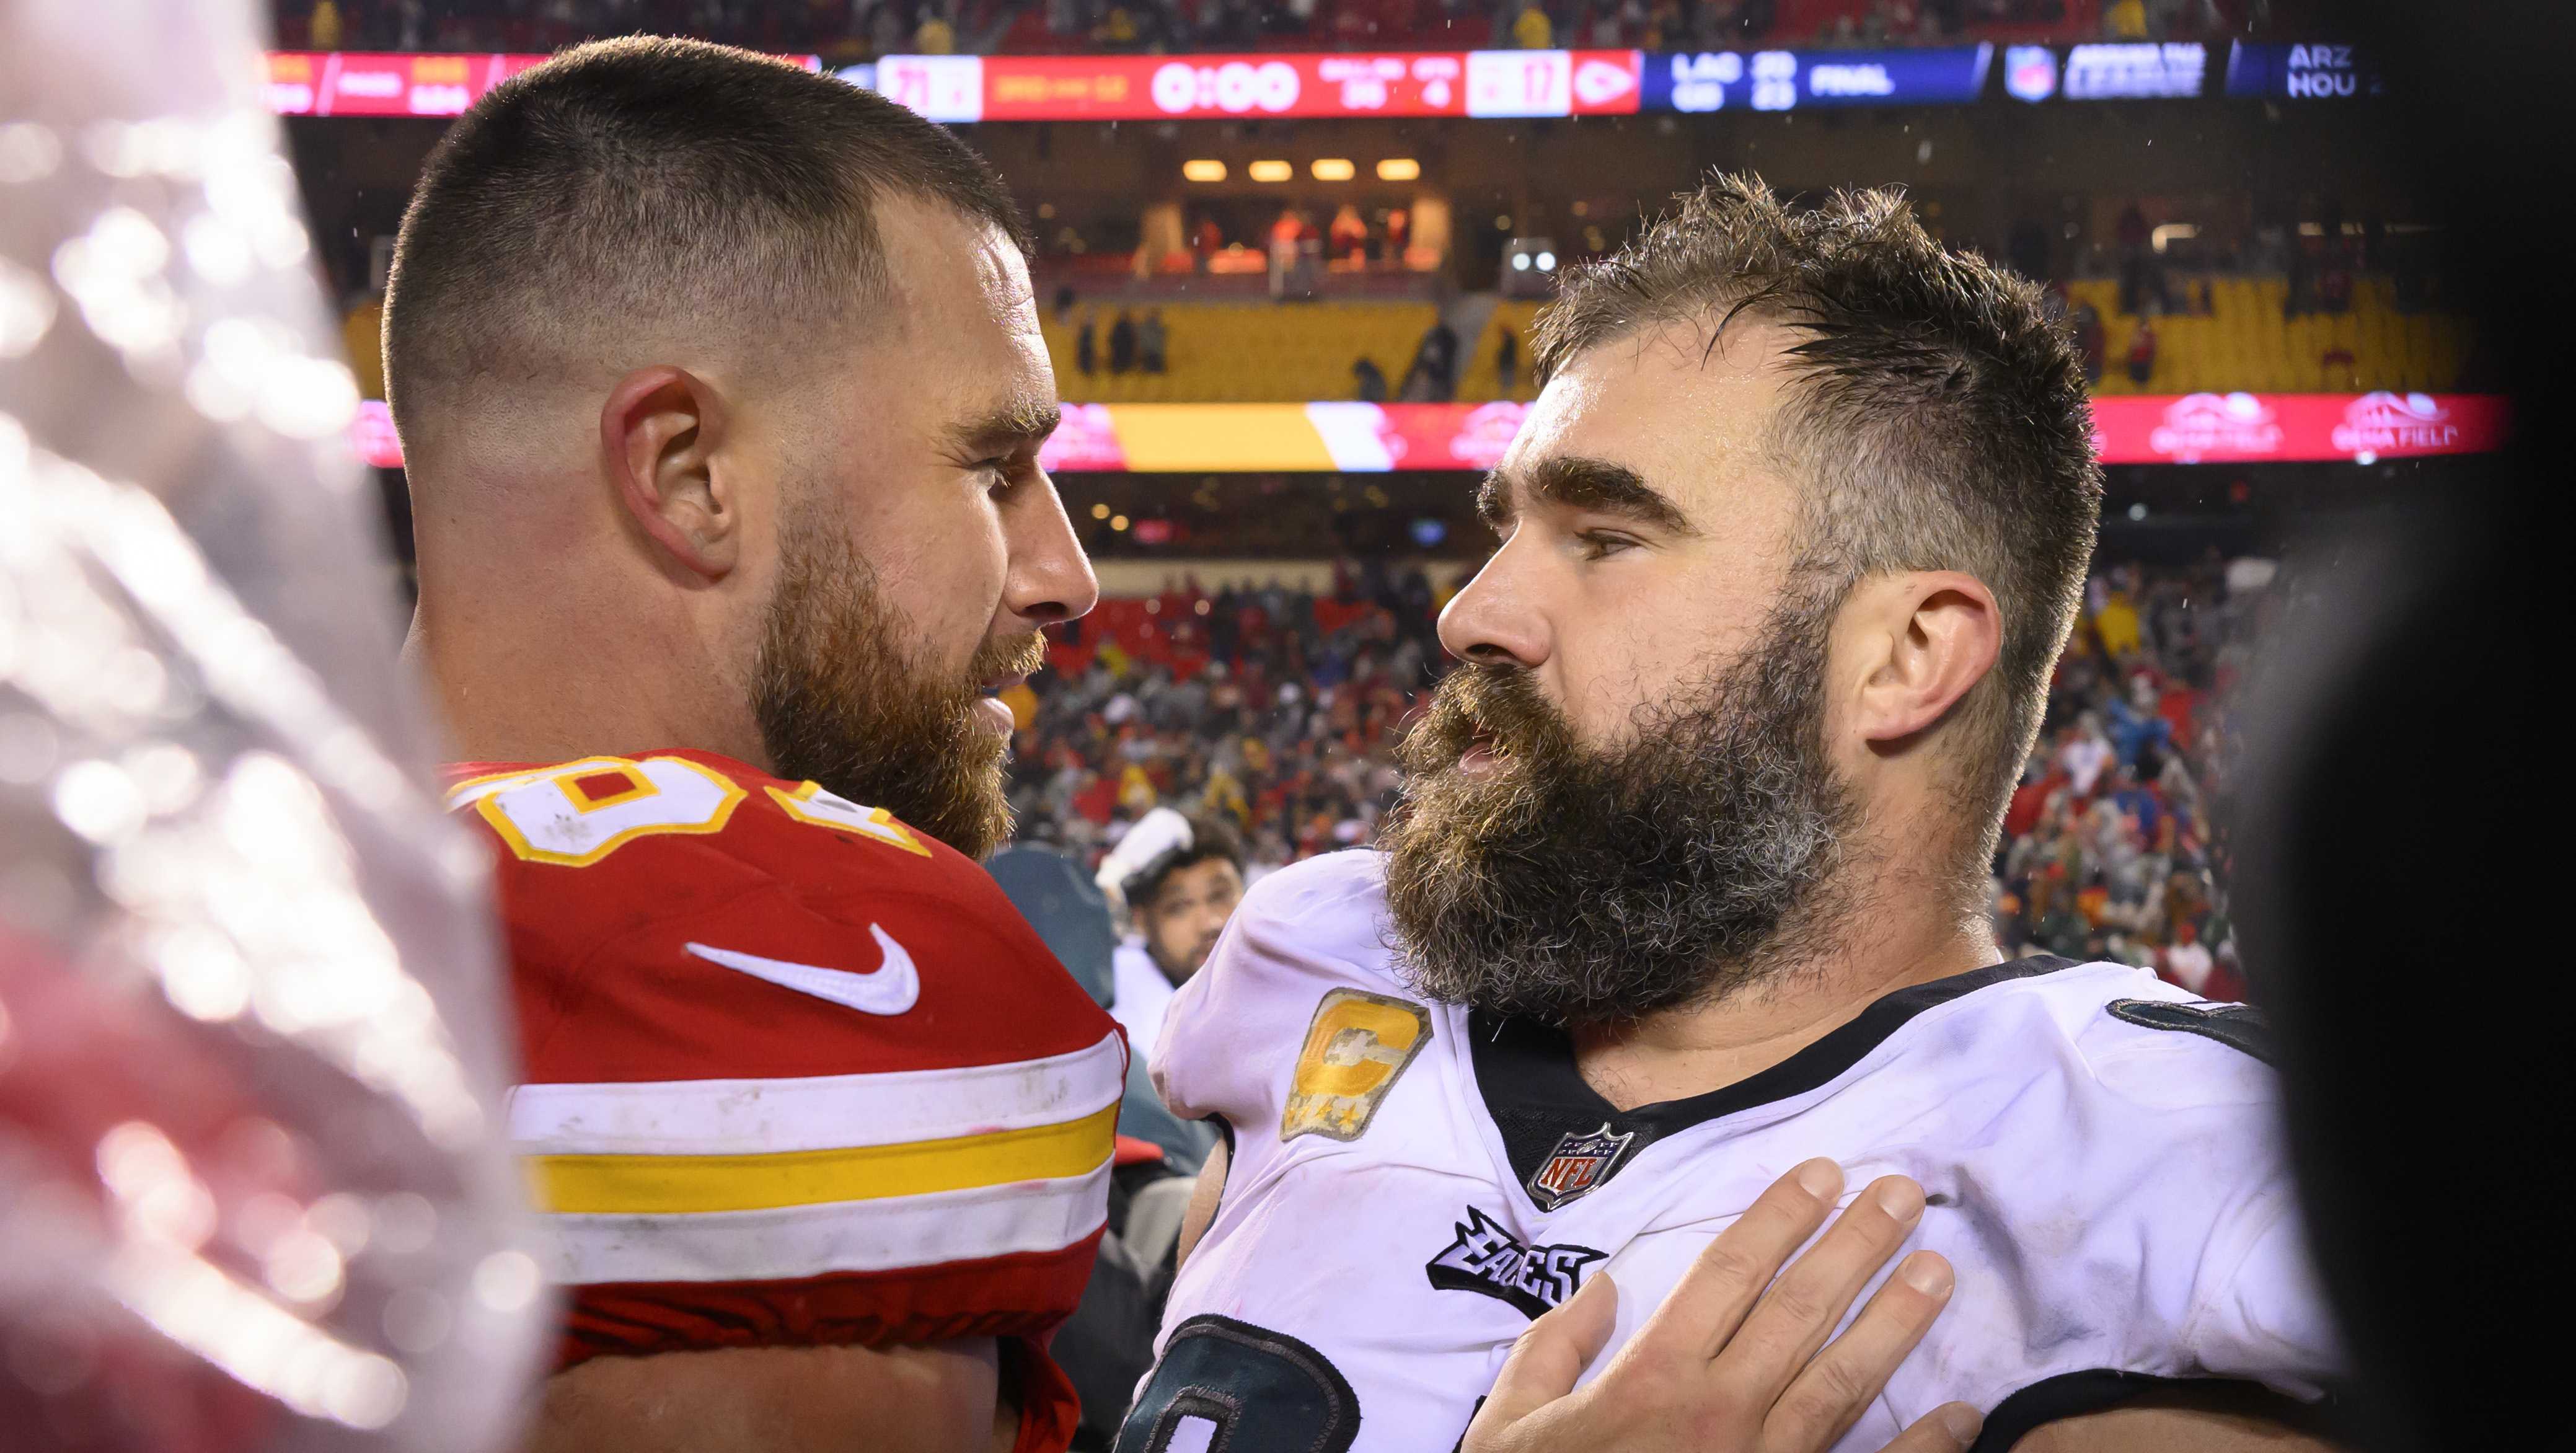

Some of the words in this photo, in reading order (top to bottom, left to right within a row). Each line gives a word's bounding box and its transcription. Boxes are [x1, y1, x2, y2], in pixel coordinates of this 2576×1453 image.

[2288, 43, 2352, 68] ARZ
[1151, 61, 1300, 113] 0:00
[2287, 71, 2355, 99] HOU
[1296, 999, 1420, 1097] C
[1538, 1157, 1598, 1192] NFL
[1431, 1212, 1593, 1309] EAGES
